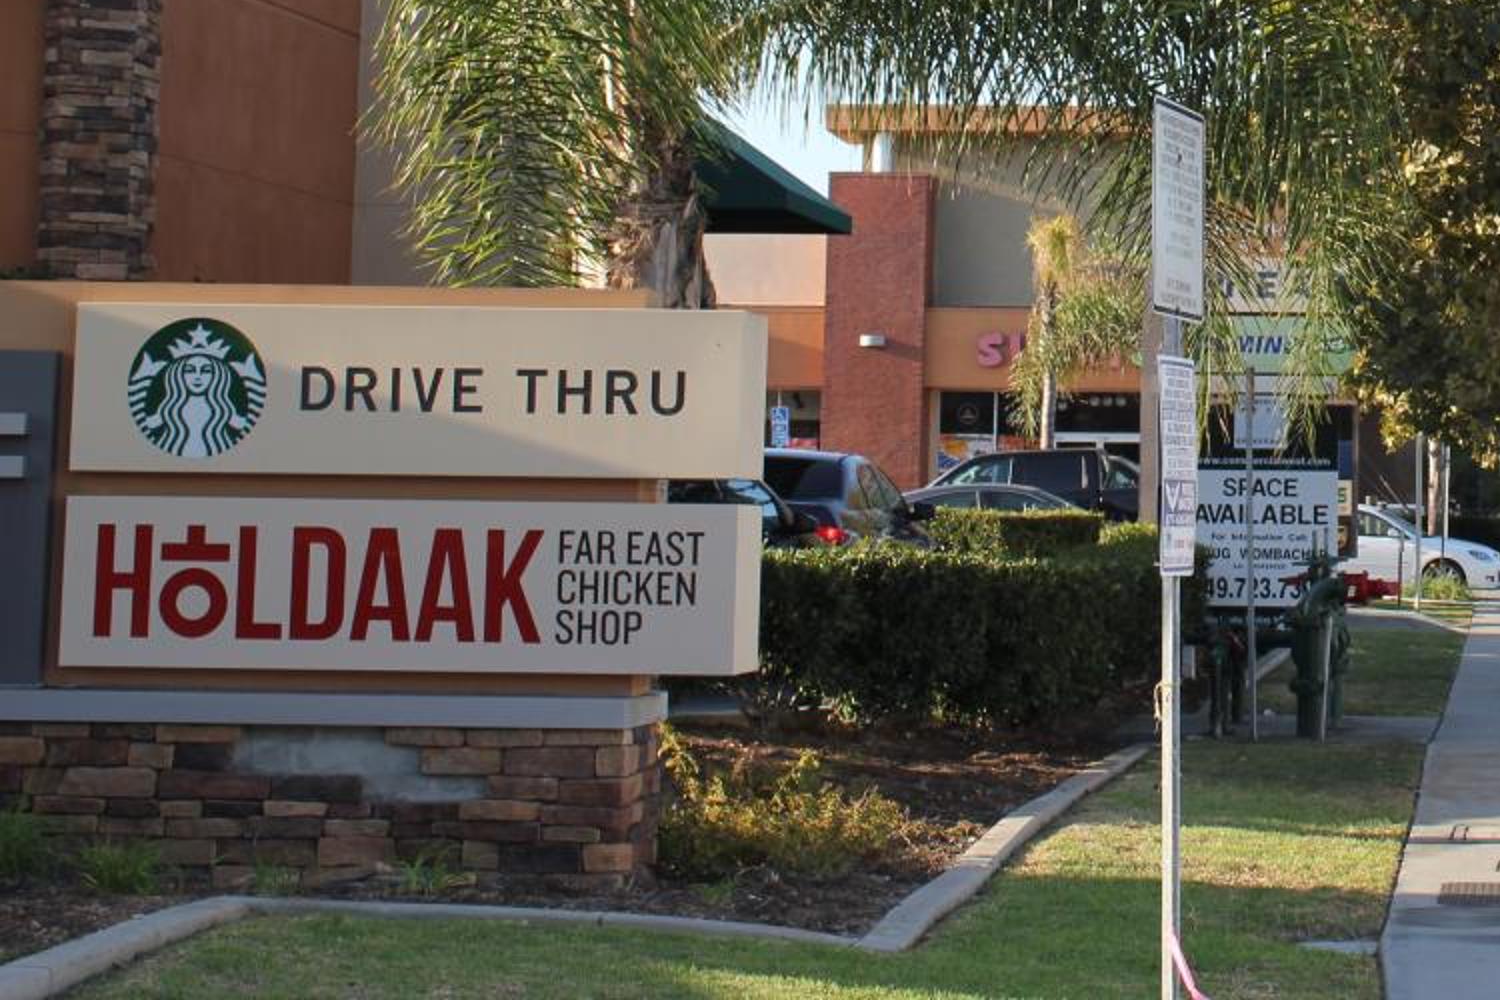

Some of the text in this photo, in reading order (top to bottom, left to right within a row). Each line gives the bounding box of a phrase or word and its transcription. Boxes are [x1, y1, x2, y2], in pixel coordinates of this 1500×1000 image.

[300, 366, 687, 416] DRIVE THRU
[559, 530, 705, 566] FAR EAST
[557, 570, 697, 606] CHICKEN
[555, 610, 643, 645] SHOP
